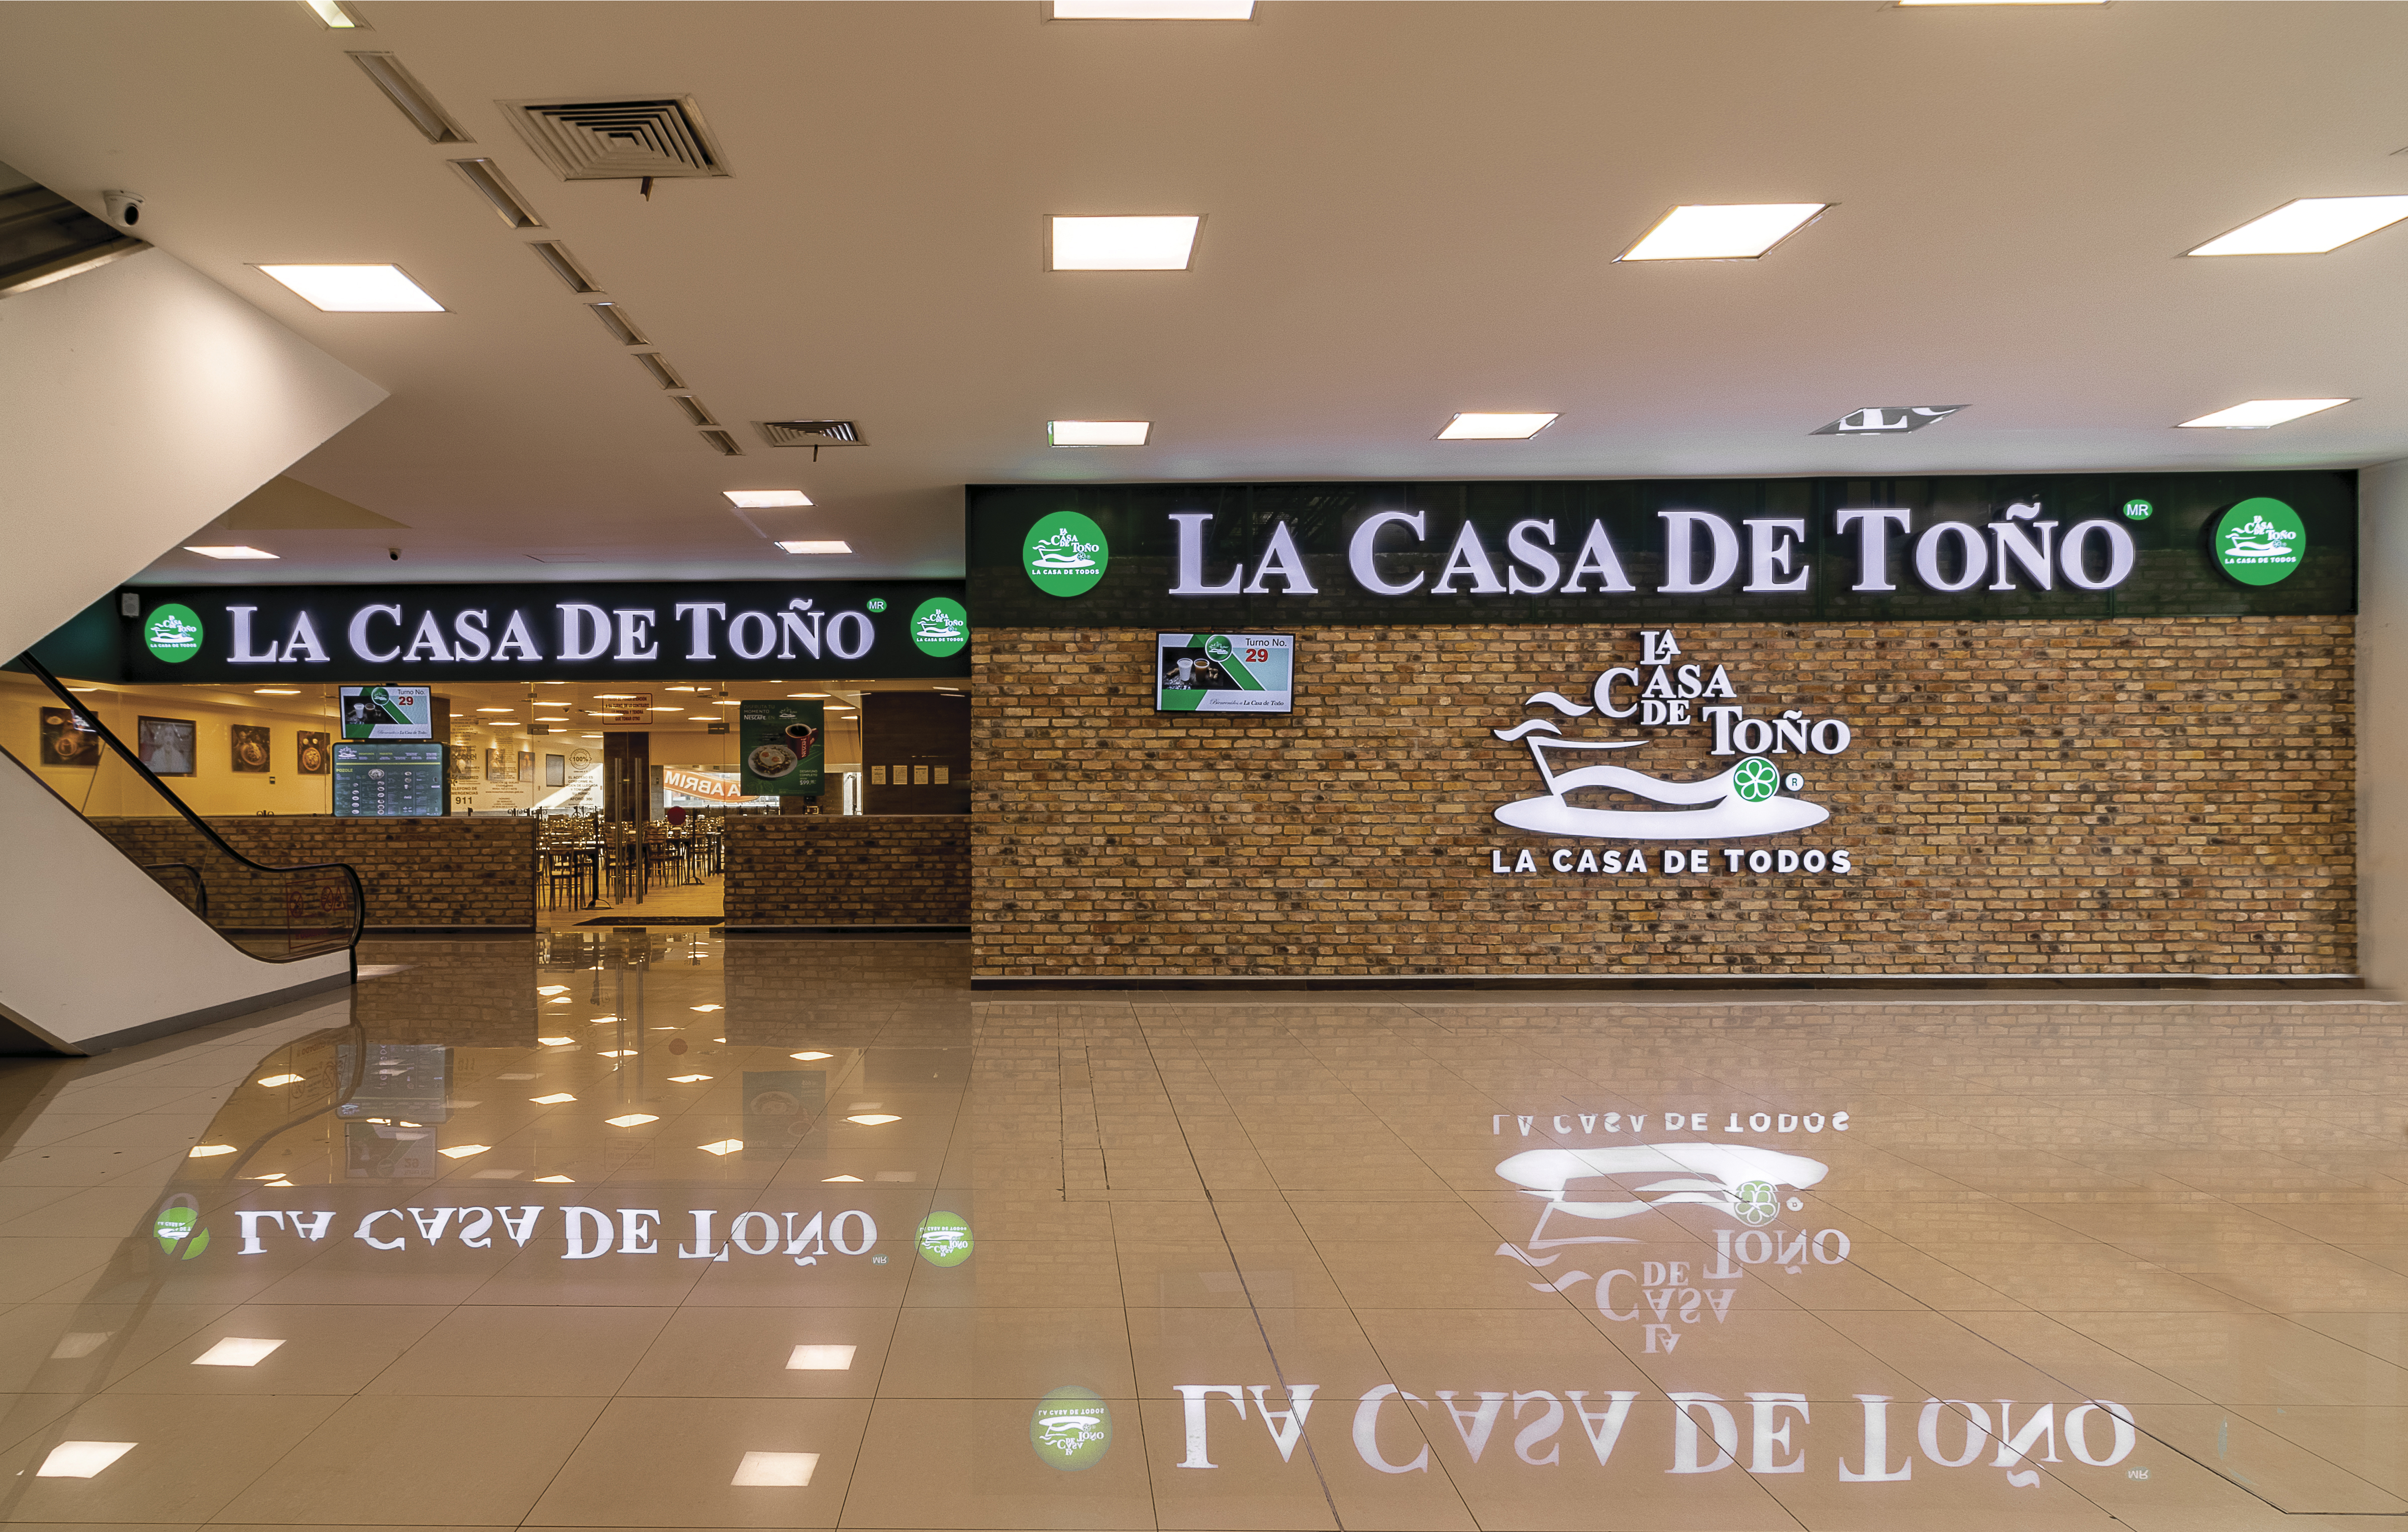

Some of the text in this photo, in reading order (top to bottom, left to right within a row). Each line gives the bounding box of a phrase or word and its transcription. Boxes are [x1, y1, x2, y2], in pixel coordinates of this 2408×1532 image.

[1050, 534, 1078, 545] CASA
[1169, 502, 2148, 595] LA CASA DE TOÑO MR
[226, 598, 884, 662] LA CASA DE TOÑO MR
[1245, 638, 1287, 646] Turno No.
[1245, 648, 1269, 663] 29
[1640, 629, 1681, 665] LA
[398, 696, 414, 706] 29
[1594, 664, 1737, 718] CASA
[1641, 700, 1691, 725] DE
[1702, 710, 1851, 755] TOÑO
[455, 796, 472, 804] 911
[1492, 849, 1851, 874] LA CASA DE TODOS
